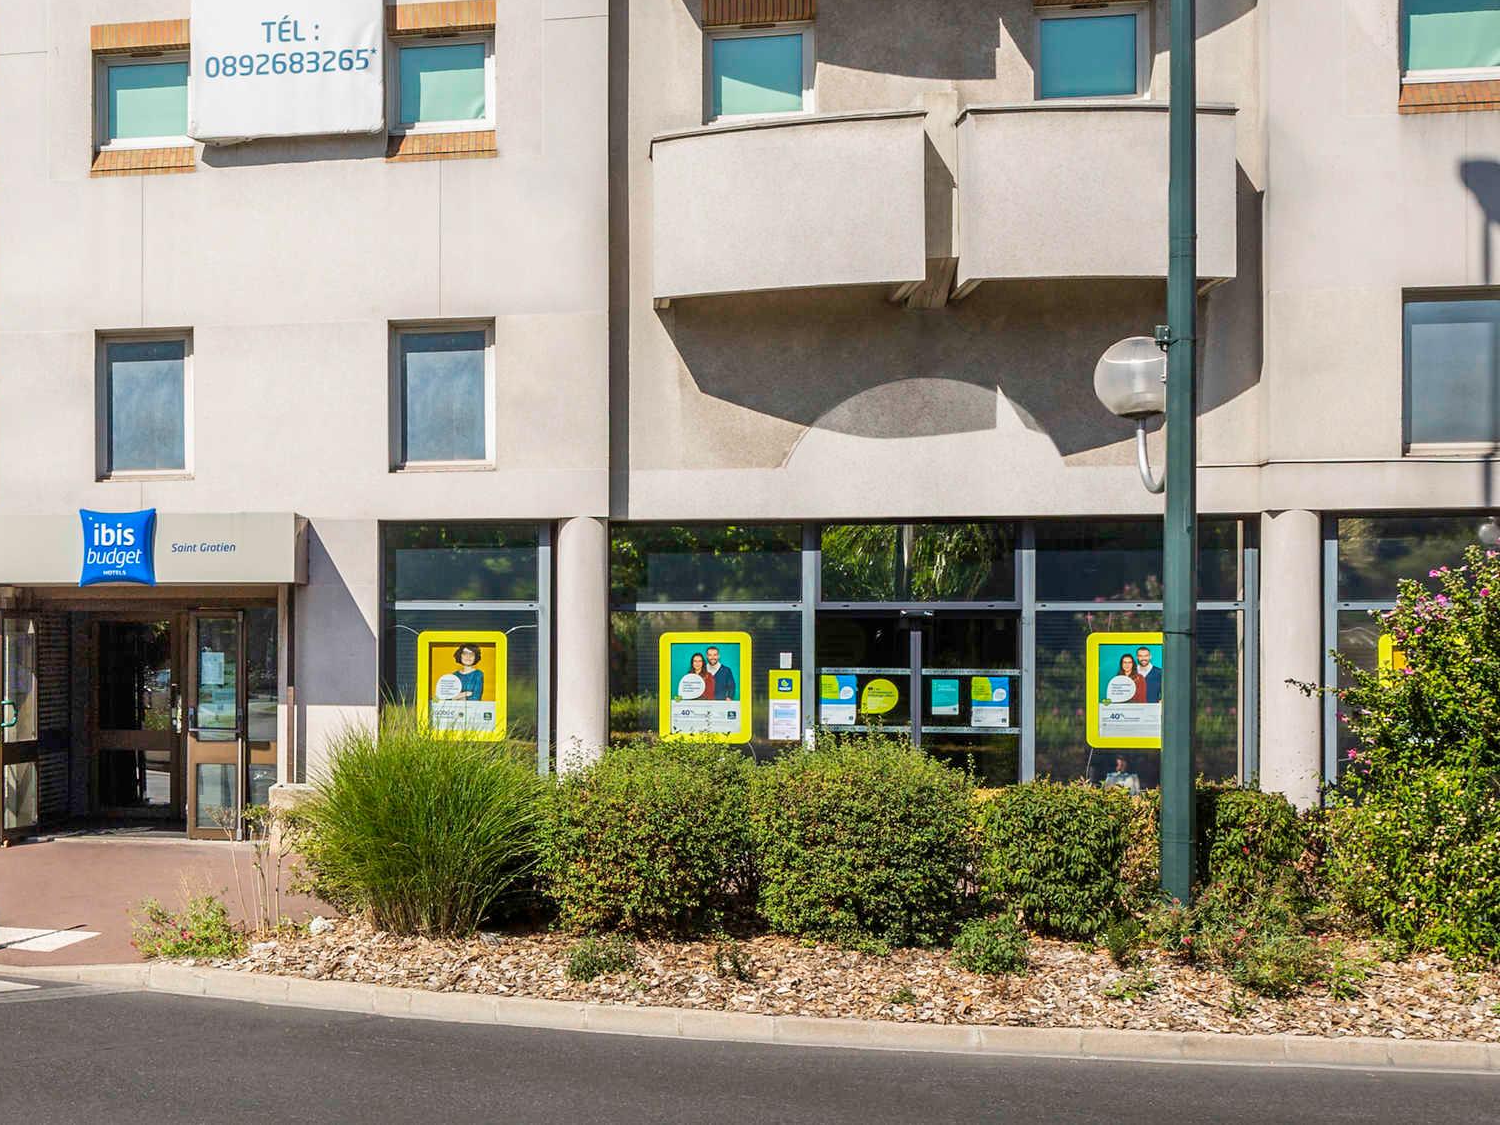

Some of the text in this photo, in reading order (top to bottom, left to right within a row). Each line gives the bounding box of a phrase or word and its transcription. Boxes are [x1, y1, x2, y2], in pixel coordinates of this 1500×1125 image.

[93, 523, 135, 546] ibis
[171, 542, 236, 553] Saint Gratien
[86, 548, 142, 568] budget
